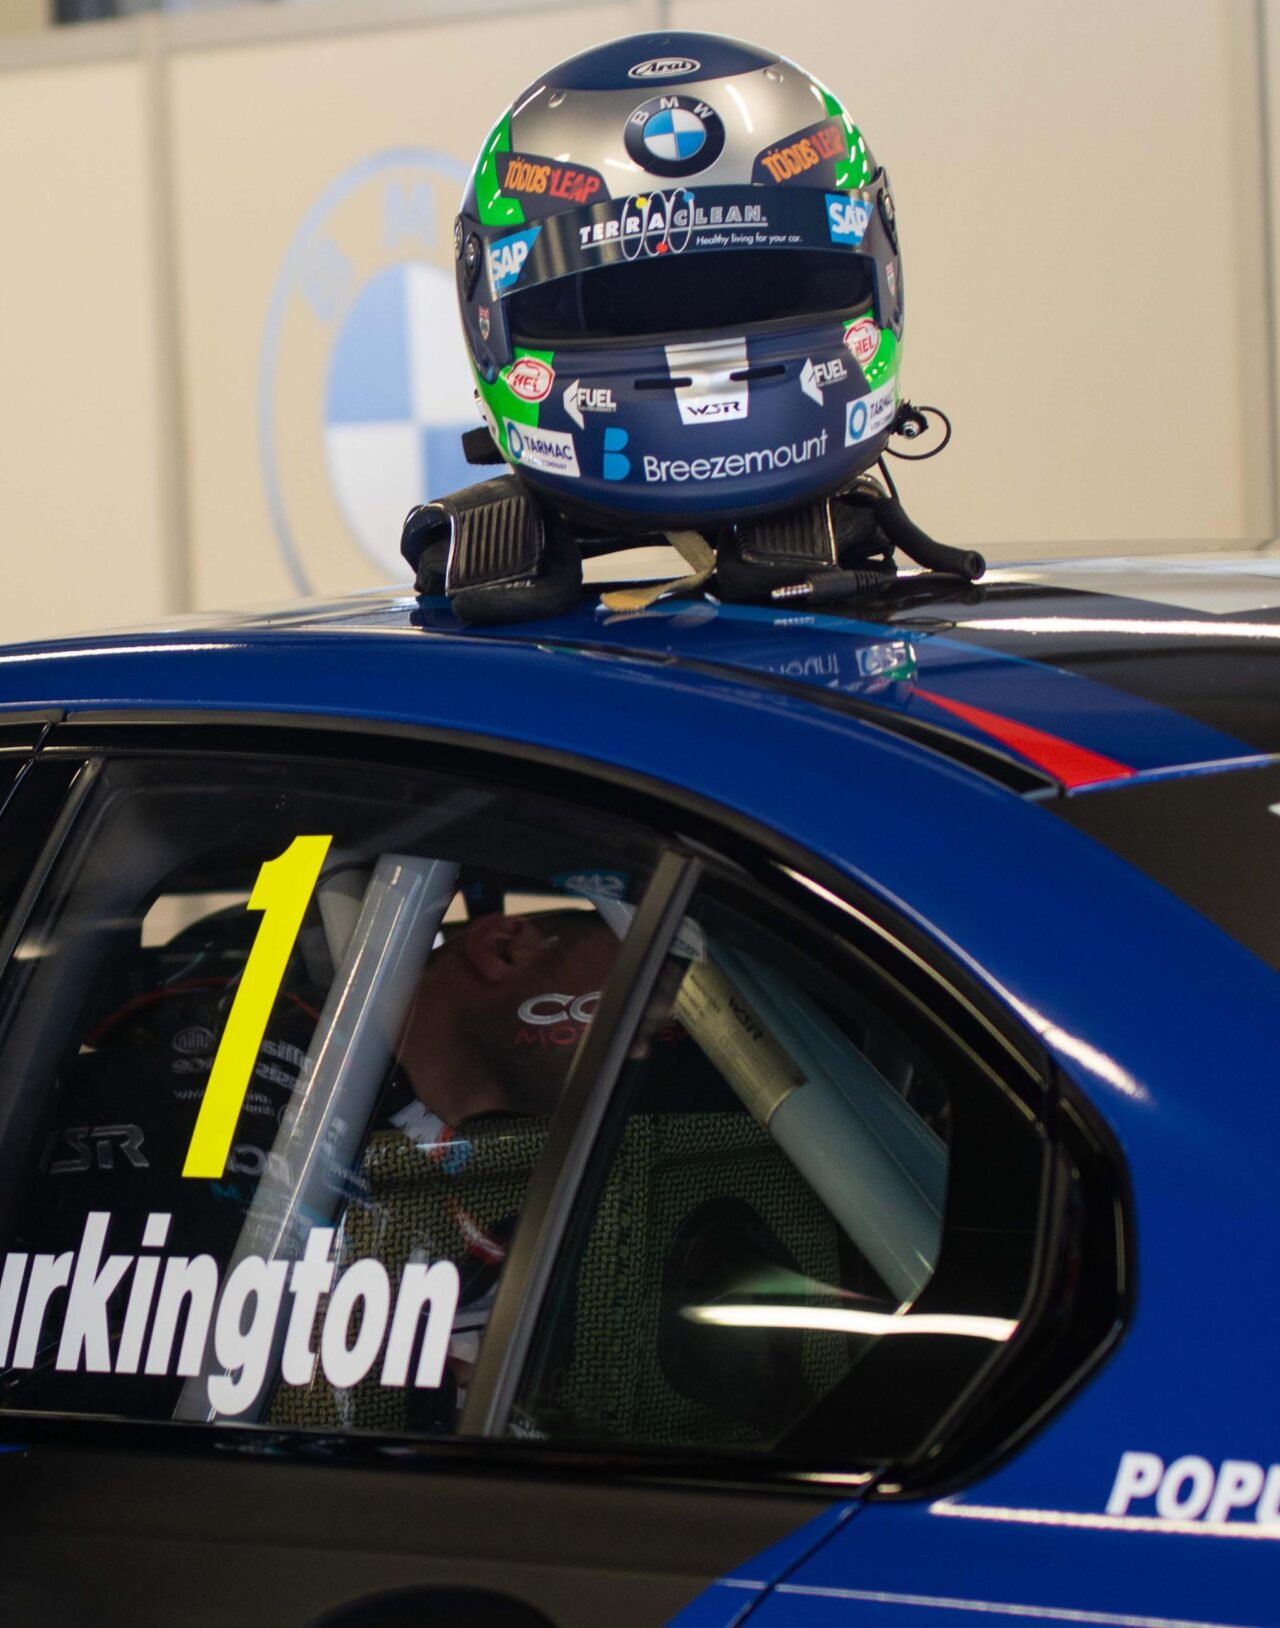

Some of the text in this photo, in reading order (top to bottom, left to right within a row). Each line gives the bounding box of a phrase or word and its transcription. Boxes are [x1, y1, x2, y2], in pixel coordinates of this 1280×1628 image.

[642, 60, 689, 75] Arai
[632, 96, 713, 126] BMW
[829, 202, 869, 238] SAP
[696, 234, 729, 247] Healthy
[730, 233, 754, 246] living
[755, 232, 768, 243] for
[768, 235, 787, 245] your
[490, 240, 529, 281] SAP
[813, 358, 848, 383] FUEL
[577, 387, 617, 408] FUEL
[523, 435, 574, 460] TARMAC
[643, 429, 828, 482] Breezemount
[181, 834, 334, 1179] 1
